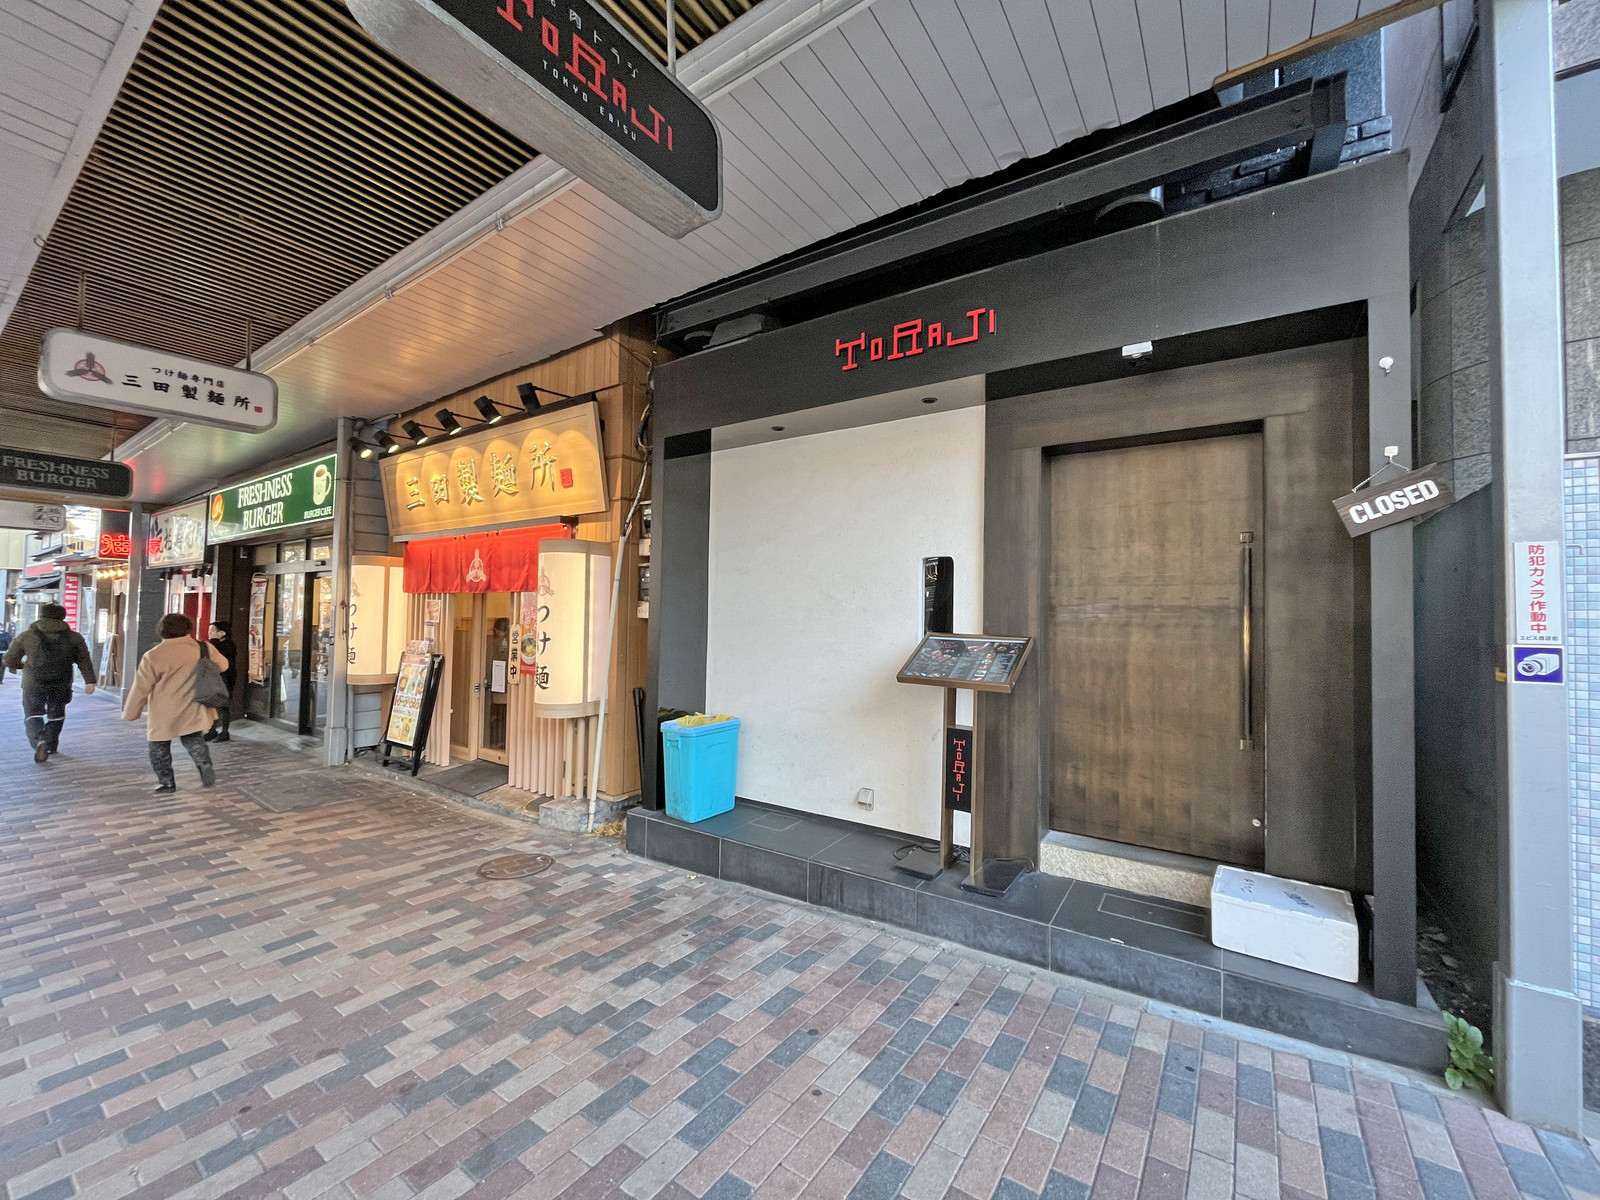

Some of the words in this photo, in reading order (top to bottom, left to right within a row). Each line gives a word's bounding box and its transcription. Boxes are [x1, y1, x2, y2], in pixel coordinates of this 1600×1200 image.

[542, 59, 588, 103] TOKYO
[600, 106, 637, 142] EBISU
[835, 308, 996, 371] TORAJI
[151, 367, 225, 389] つけ麺専門店
[2, 455, 110, 479] FRESHNESS
[17, 469, 97, 488] BURGER
[237, 472, 293, 509] FRESHNESS
[1349, 479, 1440, 524] CLOSED
[242, 501, 284, 531] BURGER
[1528, 544, 1547, 634] 防犯カメラ作動中
[952, 738, 966, 802] TORAJI
